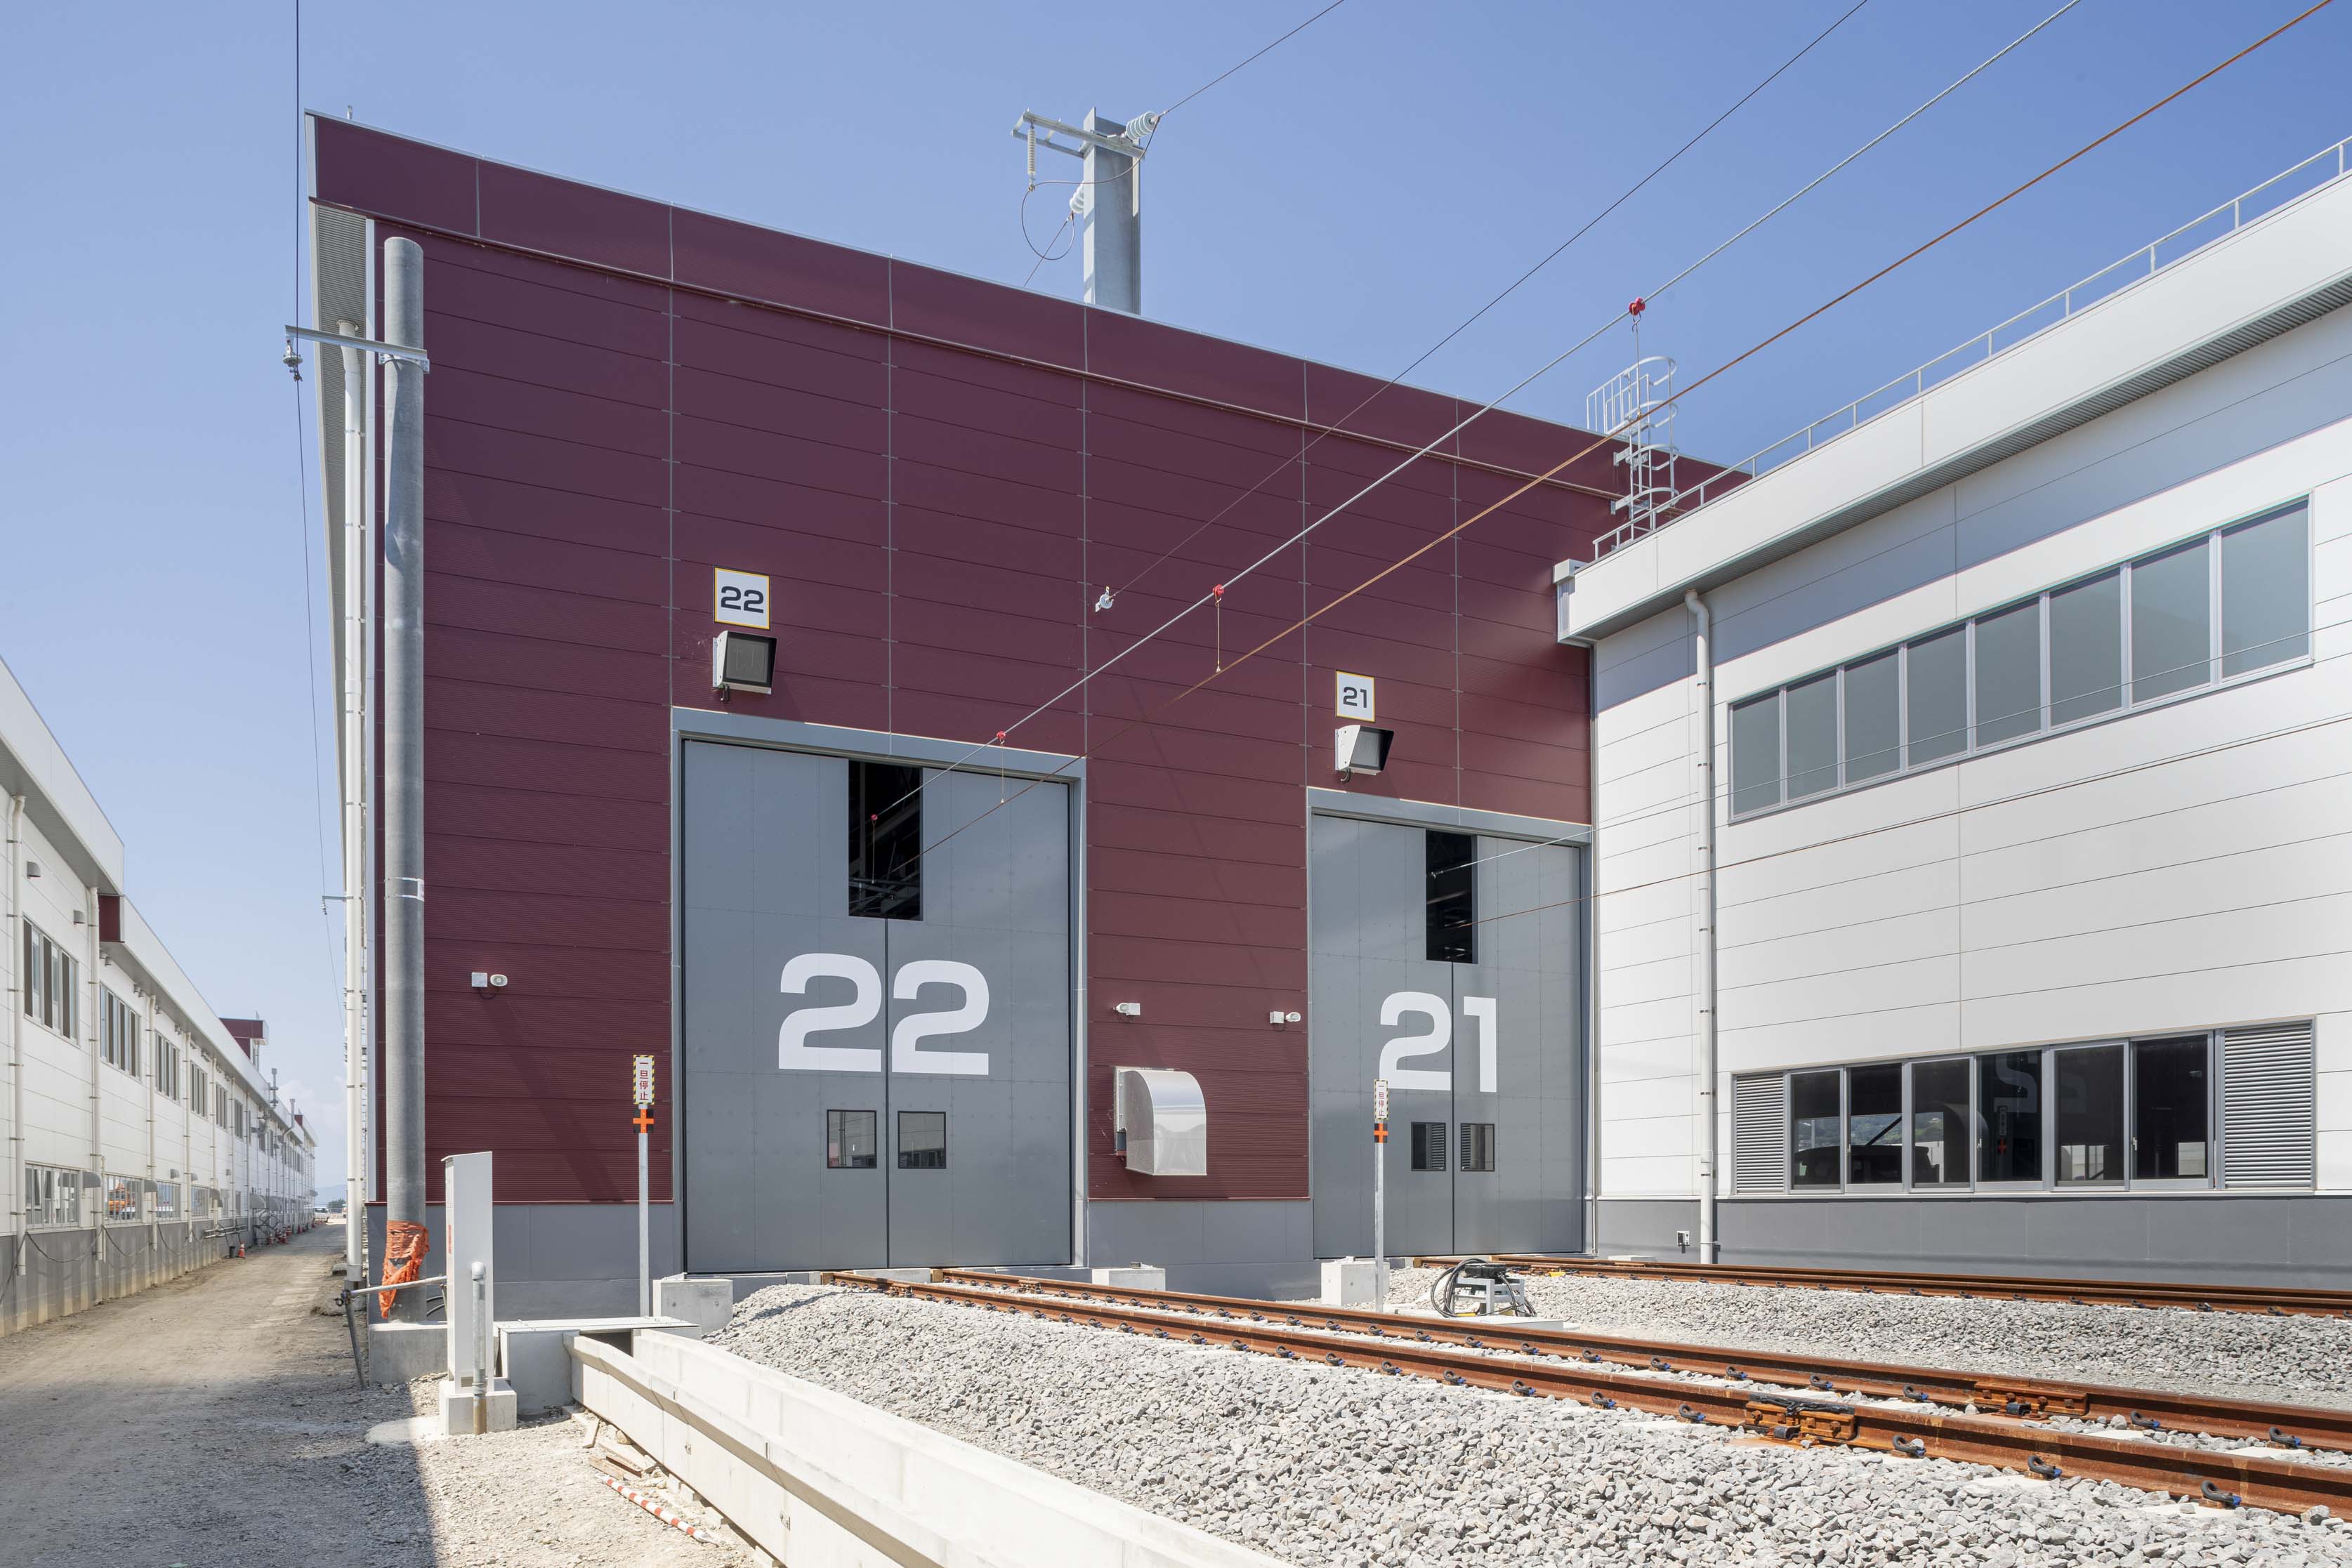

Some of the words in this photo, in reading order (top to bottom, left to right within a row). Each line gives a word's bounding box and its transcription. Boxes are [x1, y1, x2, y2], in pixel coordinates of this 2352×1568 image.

[721, 586, 764, 614] 22
[1343, 687, 1367, 709] 21
[778, 953, 990, 1075] 22
[1379, 991, 1497, 1093] 21
[639, 1062, 649, 1100] 一旦停止
